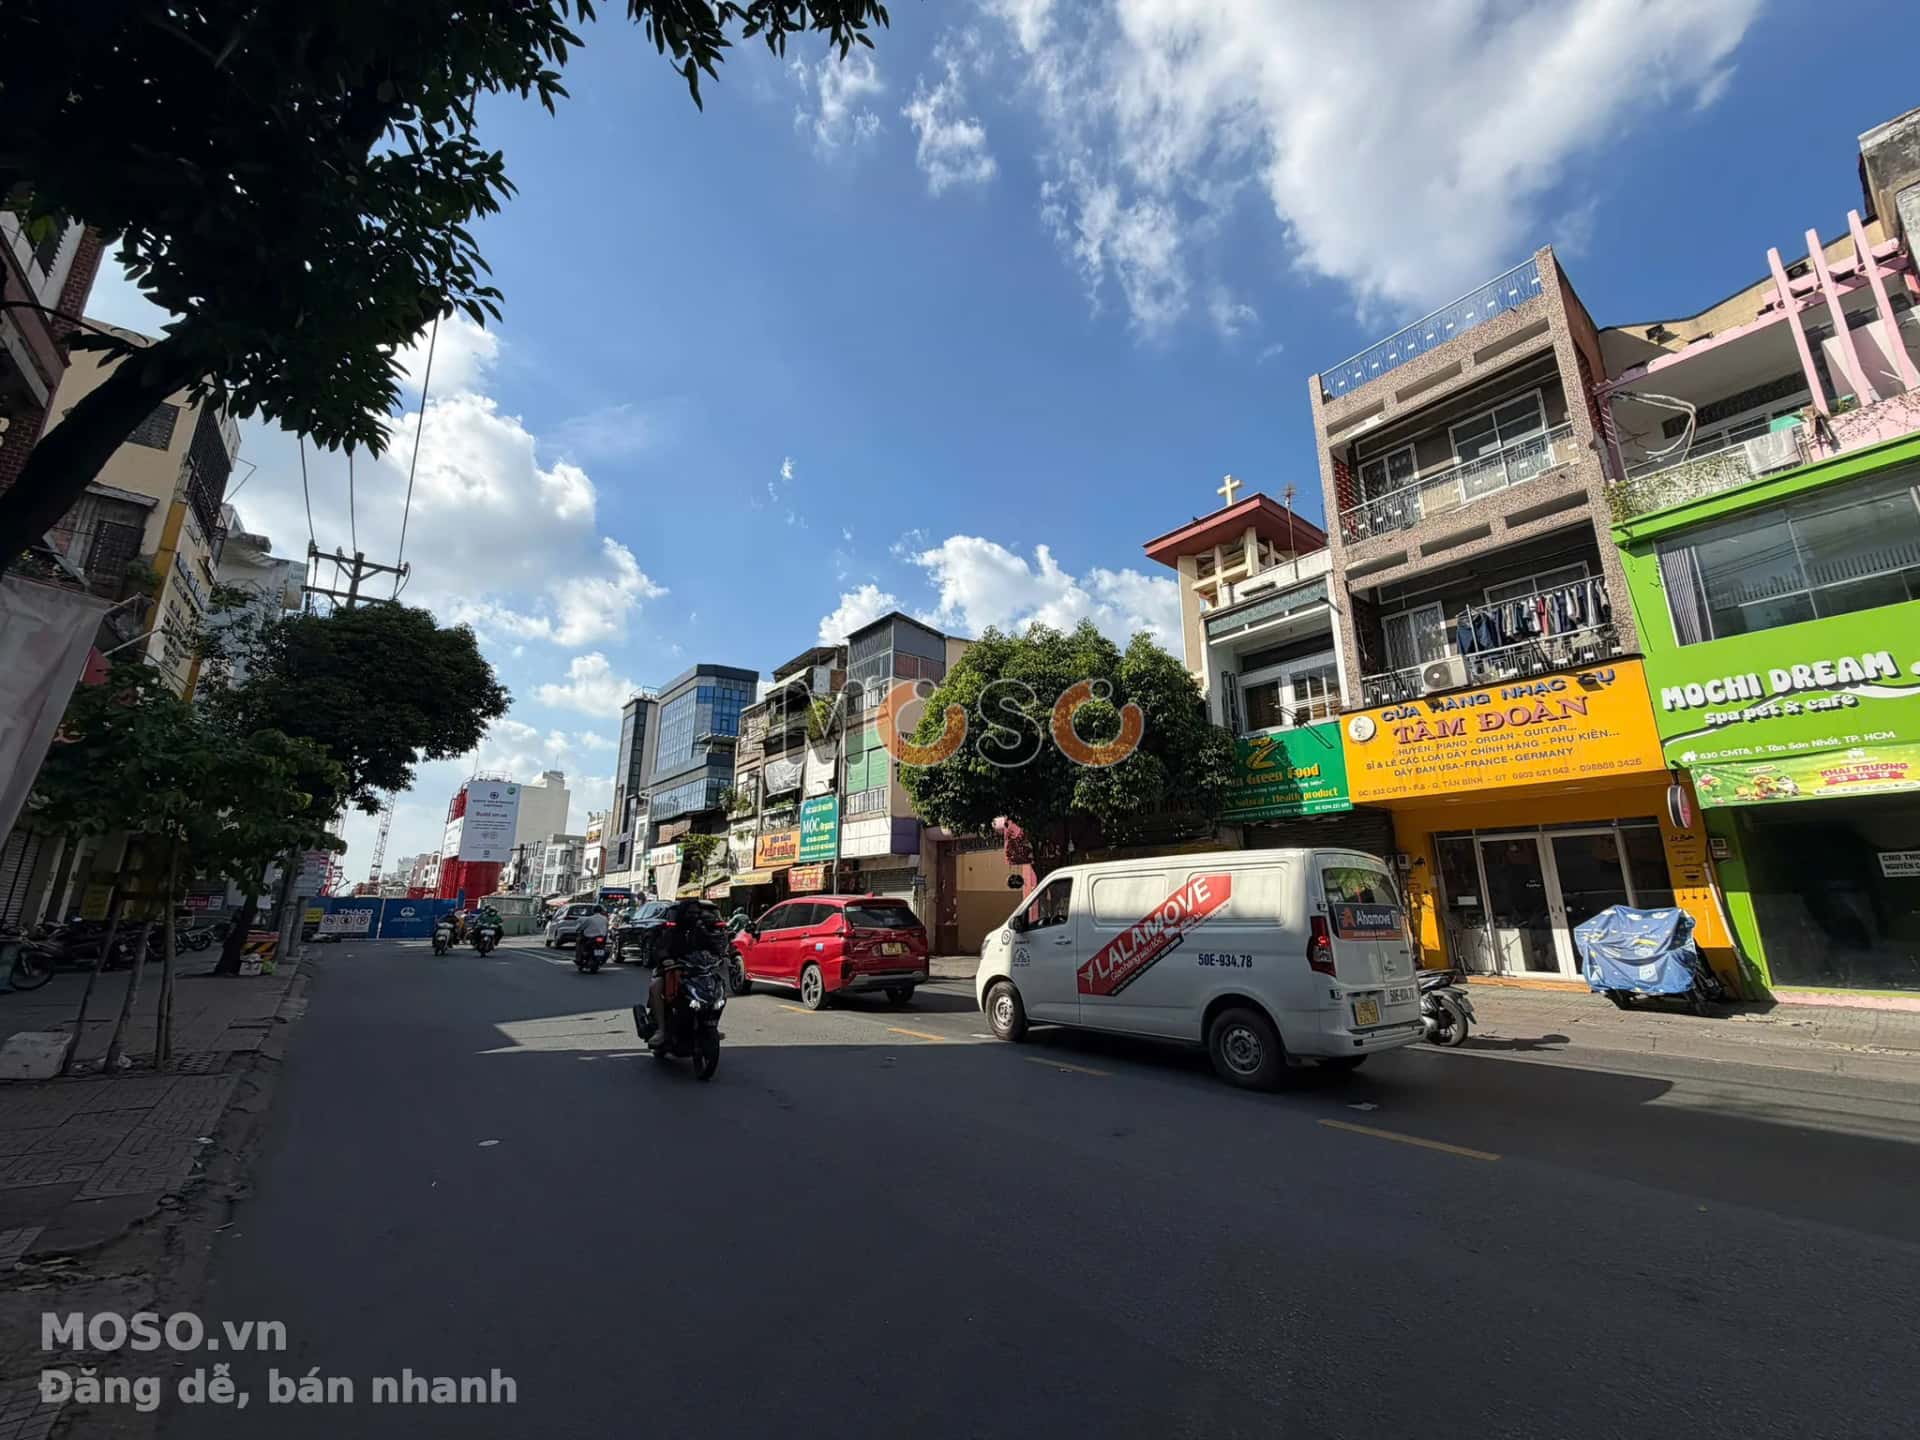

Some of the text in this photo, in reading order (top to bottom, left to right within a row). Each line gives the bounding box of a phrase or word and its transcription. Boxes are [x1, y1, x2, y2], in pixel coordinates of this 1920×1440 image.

[1661, 652, 1898, 711] MOCHI DREAM
[1382, 703, 1421, 722] CỬA
[1430, 693, 1491, 713] HÀNG
[1502, 679, 1566, 698] NHẠC
[1704, 694, 1858, 726] spa pet & cafe
[1394, 696, 1588, 744] TÂM ĐOÀN
[1437, 739, 1468, 751] PIANO
[1476, 732, 1514, 745] ORGAN
[1864, 730, 1896, 741] HCM
[1400, 754, 1418, 766] CÁC
[1471, 743, 1504, 756] CHÍNH
[1465, 755, 1508, 769] FRANCE
[1515, 747, 1574, 762] GERMANY
[1287, 763, 1321, 779] Food
[1820, 766, 1851, 777] KHAI
[1303, 787, 1339, 801] product
[1356, 910, 1391, 925] Ahamove
[1095, 877, 1212, 980] LALAMOVE
[1198, 953, 1253, 968] 50E-934.78
